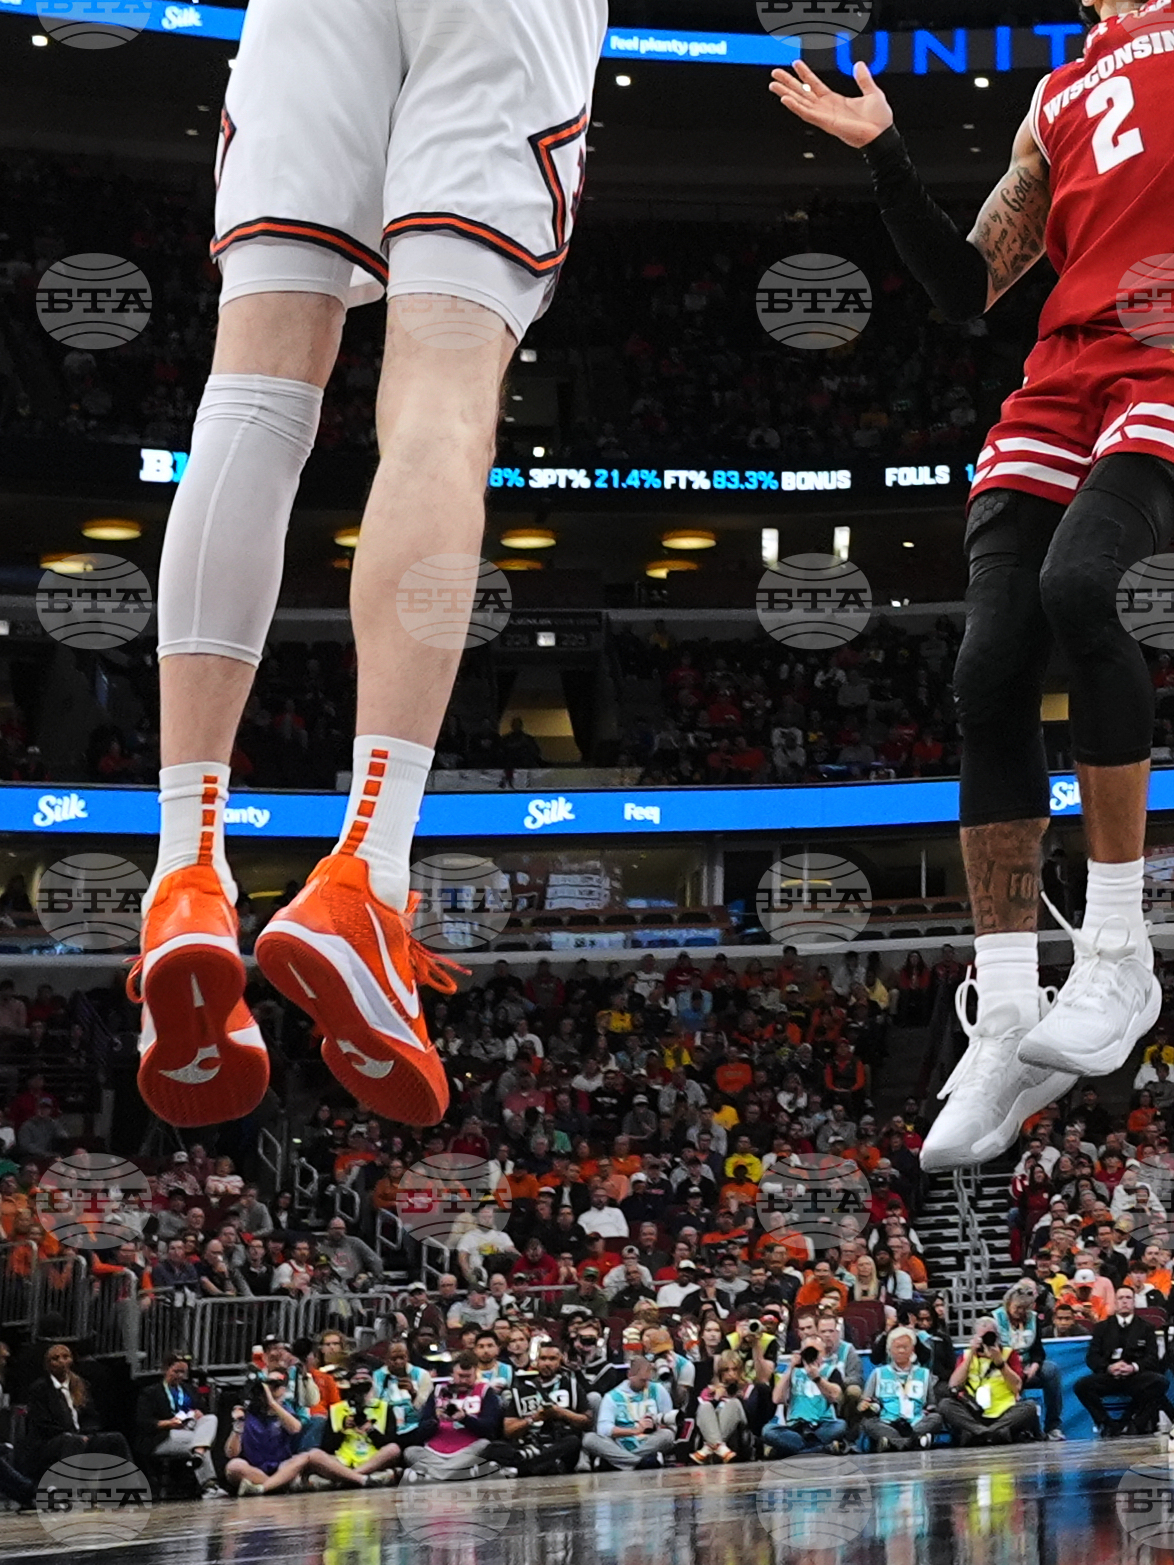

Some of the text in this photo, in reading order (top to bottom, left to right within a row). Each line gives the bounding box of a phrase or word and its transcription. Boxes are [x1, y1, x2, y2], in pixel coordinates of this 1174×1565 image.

[685, 39, 727, 60] good
[1084, 75, 1145, 175] 2
[595, 468, 662, 489] 21.4%
[664, 469, 711, 489] FT%
[712, 469, 779, 490] 83.3%
[782, 470, 851, 491] BONUS
[885, 465, 950, 487] FOULS
[33, 794, 88, 826] Silk
[523, 797, 576, 829] Silk
